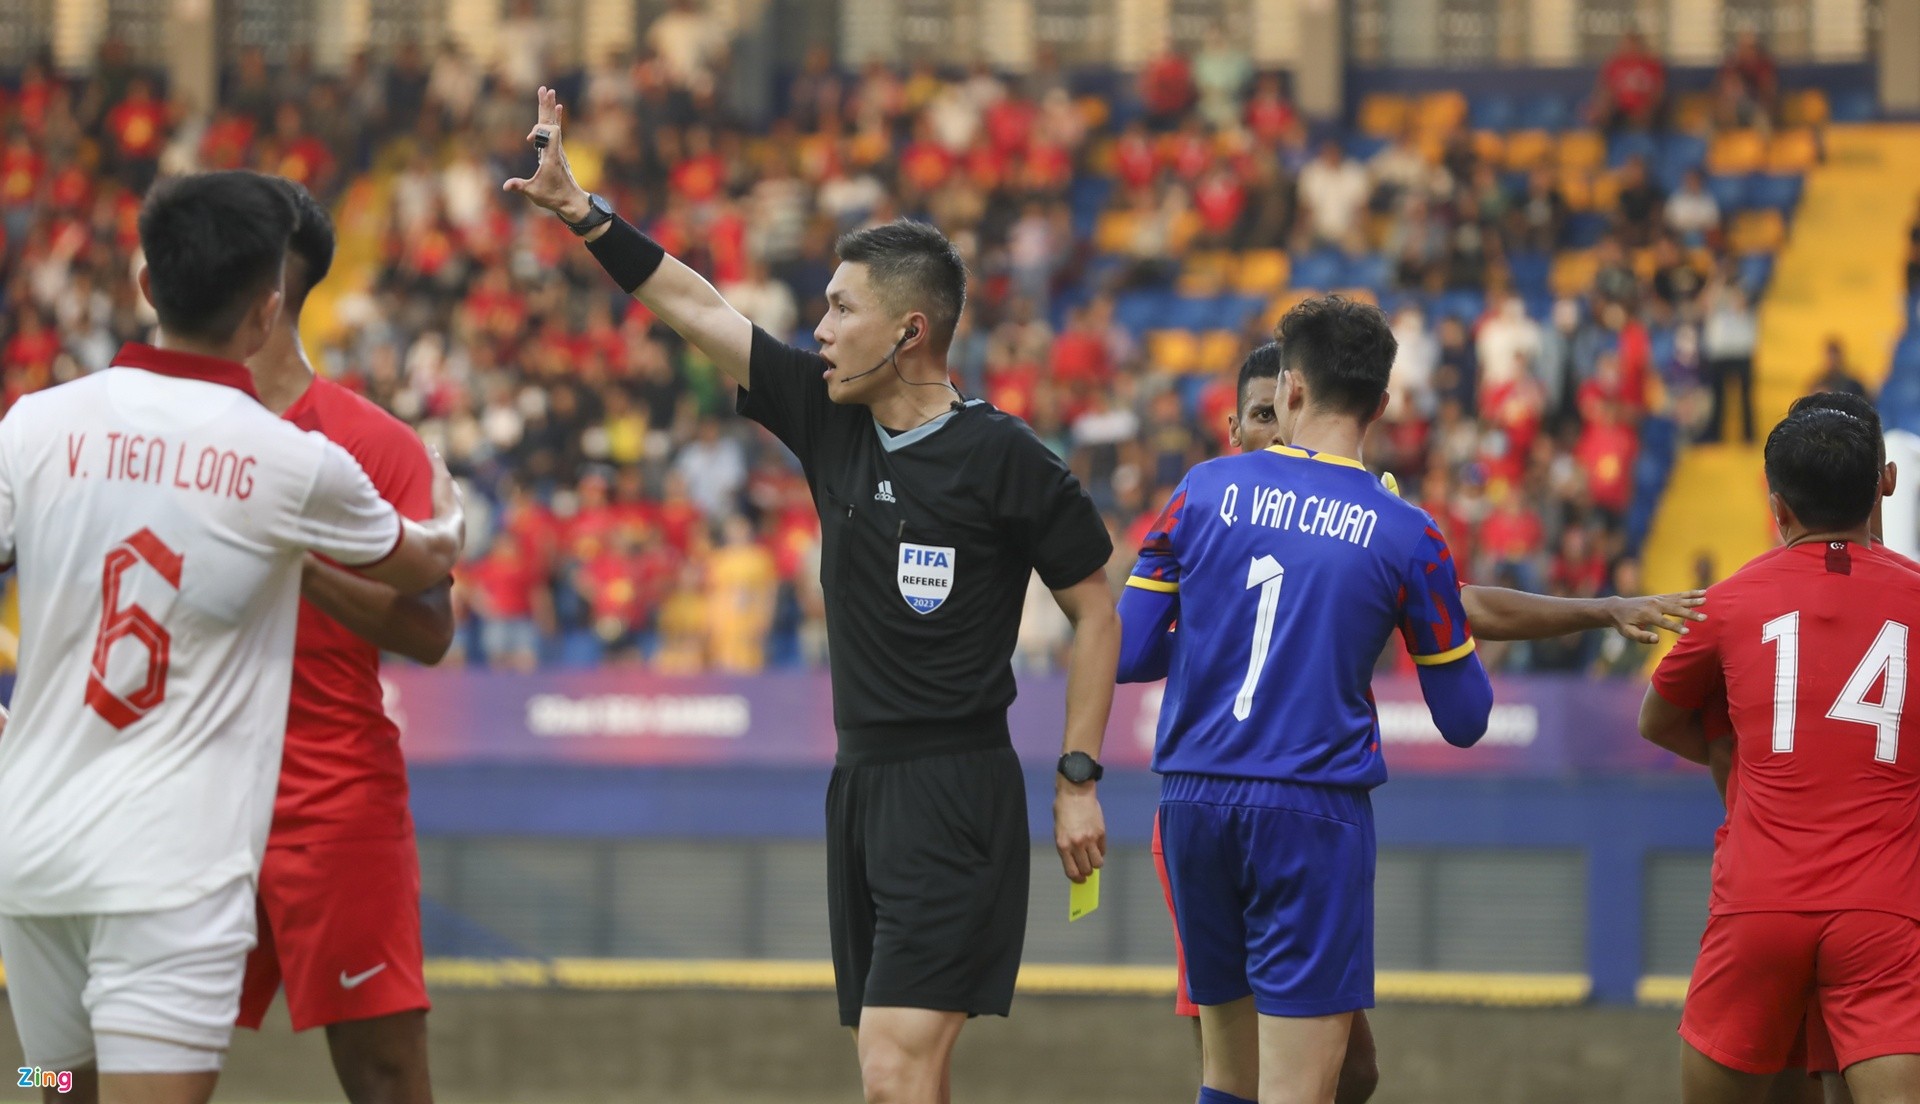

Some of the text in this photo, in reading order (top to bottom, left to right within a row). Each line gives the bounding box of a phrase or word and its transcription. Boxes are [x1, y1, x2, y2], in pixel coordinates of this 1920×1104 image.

[69, 431, 257, 501] V. TIEN LONG
[1219, 482, 1378, 548] Q. VAN CHUAN
[902, 575, 948, 588] REFEREE
[903, 547, 949, 568] FIFA
[84, 525, 185, 732] 6
[913, 598, 934, 608] 2023
[1232, 554, 1285, 722] 1
[1761, 610, 1910, 764] 14
